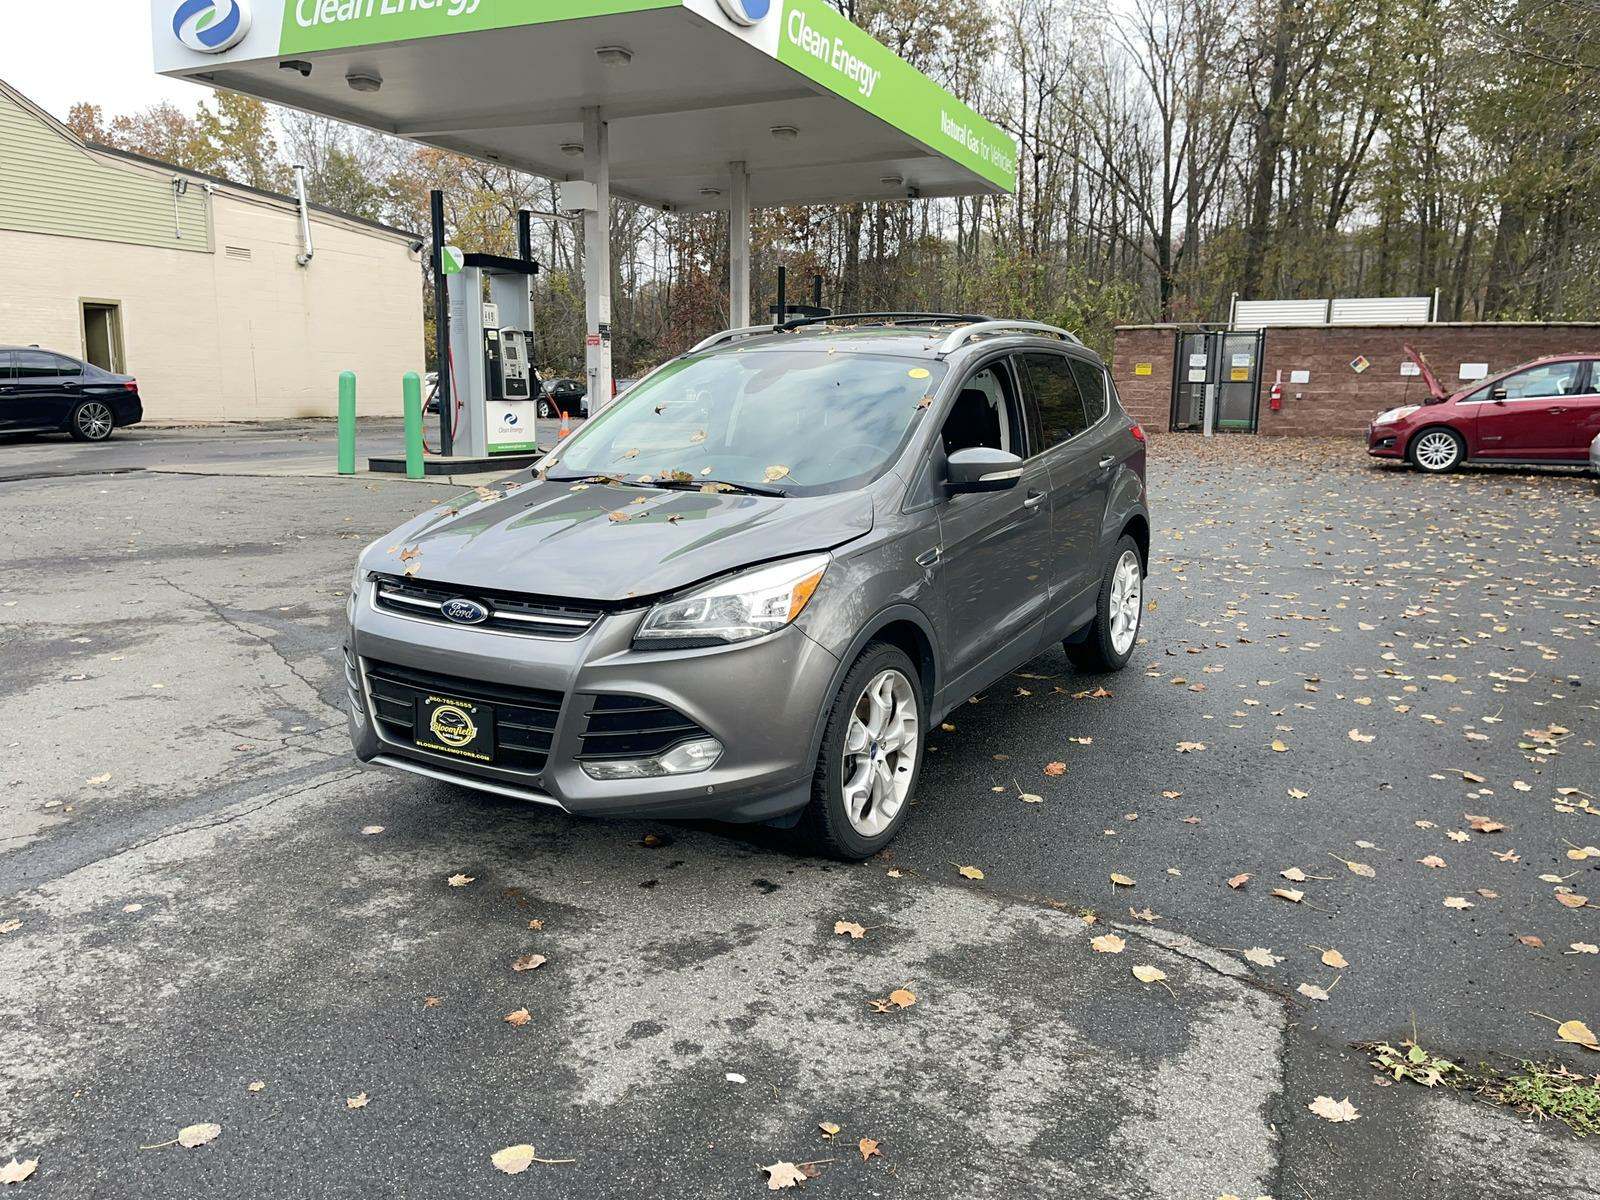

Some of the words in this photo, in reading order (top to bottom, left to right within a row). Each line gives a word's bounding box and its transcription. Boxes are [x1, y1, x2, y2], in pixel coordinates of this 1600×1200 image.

[295, 0, 373, 28] Clean
[788, 9, 830, 64] Clean
[941, 110, 967, 146] Natural
[967, 129, 980, 155] Gas
[980, 137, 990, 161] for
[990, 144, 1013, 175] Vehicles
[448, 602, 475, 619] Ford
[431, 721, 474, 737] Bloomfield
